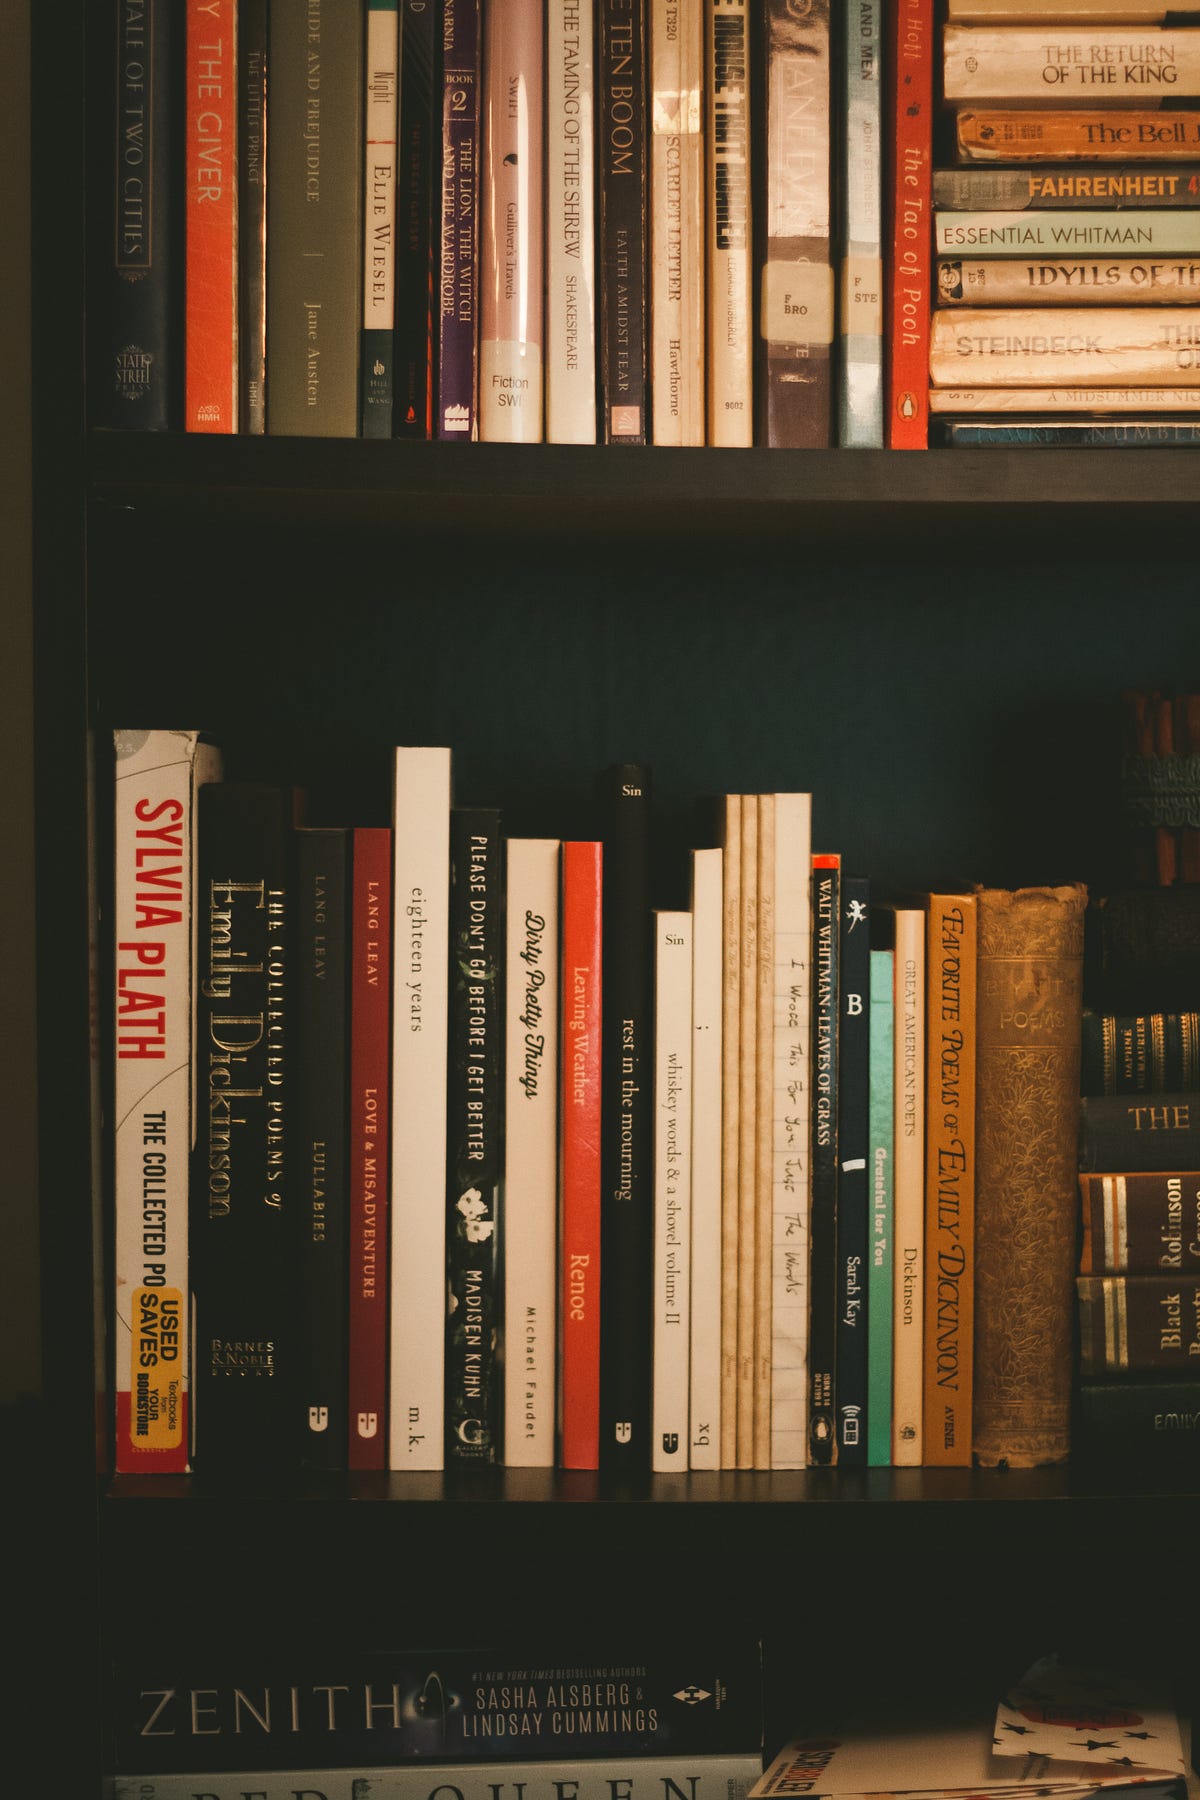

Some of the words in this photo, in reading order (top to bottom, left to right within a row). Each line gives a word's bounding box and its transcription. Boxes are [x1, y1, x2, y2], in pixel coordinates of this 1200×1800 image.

[860, 3, 872, 37] AND
[198, 38, 222, 98] THE
[307, 53, 320, 90] AND
[610, 22, 633, 75] TEN
[860, 43, 873, 81] MEN
[1042, 45, 1083, 63] THE
[1090, 45, 1175, 63] RETURN
[125, 61, 145, 92] OF
[368, 71, 395, 104] Night
[446, 75, 473, 84] BOOK
[563, 39, 580, 115] TAMING
[1042, 65, 1070, 84] OF
[1075, 66, 1117, 83] THE
[1124, 65, 1178, 84] KING
[451, 90, 467, 111] 2
[125, 104, 144, 166] TWO
[303, 99, 320, 202] PREJUDICE
[563, 119, 580, 144] OF
[610, 86, 634, 175] BOOM
[1081, 123, 1131, 143] The
[1138, 123, 1185, 143] Bell
[197, 111, 222, 203] GIVER
[443, 145, 456, 184] AND
[459, 138, 473, 172] THE
[563, 148, 580, 187] THE
[904, 148, 923, 187] the
[442, 185, 456, 217] THE
[667, 136, 681, 222] SCARLET
[1028, 176, 1180, 197] FAHRENHEIT
[124, 177, 143, 254] CITIES
[505, 202, 518, 256] Gulliver's
[563, 191, 580, 259] SHREW
[903, 198, 923, 240] Tao
[944, 227, 1045, 245] ESSENTIAL
[1050, 227, 1153, 245] WHITMAN
[459, 226, 473, 260] THE
[616, 230, 630, 277] FAITH
[667, 228, 682, 301] LETTER
[900, 251, 922, 277] of
[441, 224, 456, 317] WARDROBE
[505, 261, 518, 300] Travels
[1027, 265, 1121, 287] IDYLLS
[1129, 264, 1164, 288] OF
[459, 266, 473, 322] WITCH
[616, 285, 630, 345] AMIDST
[784, 304, 808, 315] BRO
[854, 293, 878, 303] STE
[902, 288, 922, 345] Pooh
[303, 302, 322, 340] Jane
[565, 275, 579, 371] SHAKESPEARE
[956, 336, 1102, 357] STEINBECK
[306, 348, 321, 406] Austen
[492, 374, 529, 389] Fiction
[617, 352, 630, 391] FEAR
[669, 338, 682, 416] Hawthorne
[197, 413, 221, 422] HMH
[1066, 390, 1165, 402] MIDSUMMER
[621, 784, 642, 797] Sin
[135, 798, 184, 929] SYLVIA
[469, 836, 488, 893] PLEASE
[314, 875, 326, 924] LANG
[367, 882, 380, 929] LANG
[818, 878, 832, 923] WALT
[406, 887, 428, 973] eighteen
[469, 900, 487, 951] DON'T
[519, 909, 546, 967] Dirty
[665, 933, 685, 945] Sin
[314, 936, 326, 980] LEAV
[366, 942, 379, 986] LEAV
[468, 959, 487, 980] GO
[817, 924, 832, 1007] WHITMAN
[940, 906, 965, 1022] FAVORITE
[118, 942, 166, 1059] PLATH
[406, 982, 423, 1032] years
[519, 969, 546, 1030] Pretty
[569, 965, 590, 1031] Leaving
[788, 985, 802, 1028] Wrote
[846, 993, 863, 1016] B
[904, 960, 917, 1008] GREAT
[467, 986, 486, 1046] BEFORE
[622, 1018, 635, 1051] rest
[622, 1056, 641, 1074] in
[789, 1042, 804, 1067] This
[816, 1016, 832, 1070] LEAVES
[904, 1012, 917, 1088] AMERICAN
[467, 1065, 485, 1094] GET
[519, 1034, 545, 1100] Things
[572, 1033, 591, 1105] Weather
[661, 1052, 684, 1113] whiskey
[816, 1073, 831, 1095] OF
[940, 1028, 964, 1106] POEMS
[364, 1088, 378, 1134] LOVE
[622, 1079, 641, 1107] the
[787, 1079, 803, 1105] For
[143, 1111, 166, 1145] THE
[466, 1101, 485, 1160] BETTER
[816, 1097, 831, 1146] GRASS
[904, 1094, 916, 1137] POETS
[942, 1113, 959, 1135] OF
[1127, 1105, 1191, 1132] THE
[266, 1100, 286, 1181] POEMS
[364, 1141, 375, 1150] &
[614, 1113, 638, 1201] mourning
[666, 1118, 682, 1163] words
[312, 1141, 326, 1242] LULLABIES
[666, 1168, 681, 1180] &
[666, 1186, 676, 1195] a
[873, 1146, 888, 1210] Grateful
[938, 1138, 967, 1241] EMILY
[142, 1152, 167, 1256] COLLECTED
[666, 1200, 682, 1246] shovel
[785, 1212, 807, 1237] The
[873, 1213, 888, 1234] for
[1159, 1178, 1183, 1269] Robinson
[362, 1157, 377, 1298] MISADVENTURE
[873, 1238, 888, 1266] You
[570, 1253, 590, 1321] Renoe
[665, 1251, 681, 1307] volume
[846, 1256, 861, 1296] Sarah
[903, 1248, 918, 1325] Dickinson
[139, 1293, 159, 1368] SAVES
[160, 1300, 178, 1362] USED
[463, 1270, 484, 1346] MADISEN
[843, 1299, 861, 1327] Kay
[936, 1244, 967, 1391] DICKINSON
[1159, 1292, 1182, 1351] Black
[525, 1306, 537, 1371] Michael
[463, 1352, 482, 1397] KUHN
[136, 1373, 150, 1436] BOOKSTORE
[149, 1389, 159, 1421] YOUR
[168, 1380, 179, 1430] Textbooks
[525, 1382, 537, 1439] Faudet
[944, 1405, 955, 1450] AVENEL
[140, 1684, 403, 1736] ZENITH
[476, 1686, 538, 1710] SASHA
[547, 1683, 630, 1707] ALSBERG
[462, 1712, 544, 1738] LINDSAY
[551, 1708, 659, 1734] CUMMINGS
